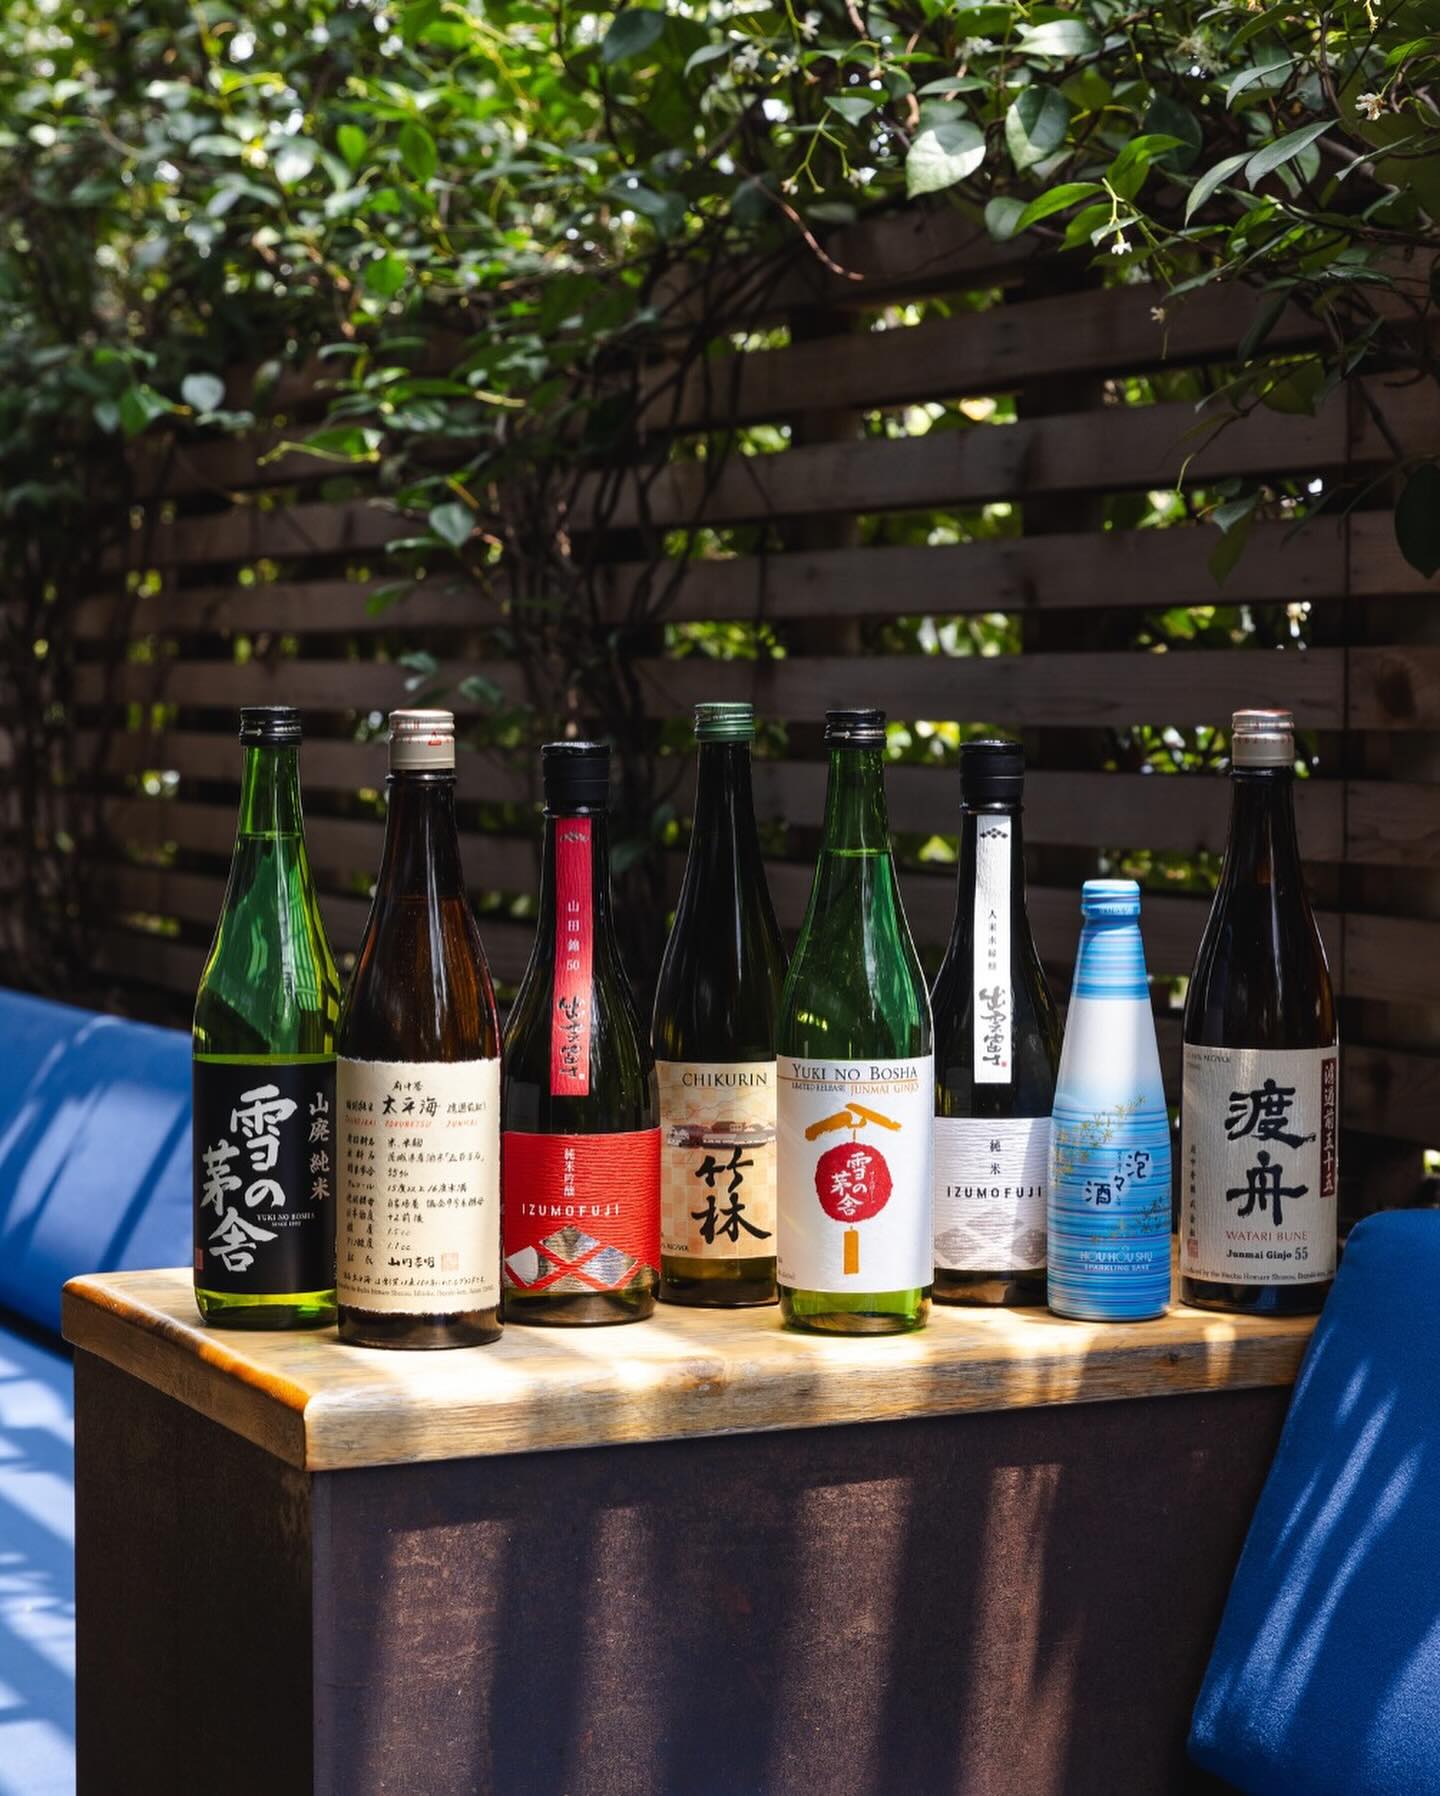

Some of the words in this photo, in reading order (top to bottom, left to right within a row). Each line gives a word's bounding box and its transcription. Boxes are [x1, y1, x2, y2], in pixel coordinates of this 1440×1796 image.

[682, 1072, 768, 1087] CHIKURIN
[835, 1068, 861, 1081] NO
[870, 1066, 919, 1081] BOSHA
[850, 1084, 890, 1096] JUNMAI
[893, 1083, 919, 1095] GINJO
[383, 1095, 438, 1117] 太平海
[1225, 1078, 1316, 1226] 渡舟
[691, 1146, 773, 1245] 竹林
[947, 1186, 1042, 1199] IZUMOFUJI
[522, 1202, 619, 1217] IZUMOFUJI
[1225, 1231, 1273, 1242] WATARI
[1276, 1232, 1309, 1242] BUNE
[1226, 1249, 1264, 1260] Junmai
[1266, 1250, 1293, 1262] Ginjo
[1294, 1247, 1309, 1261] 55
